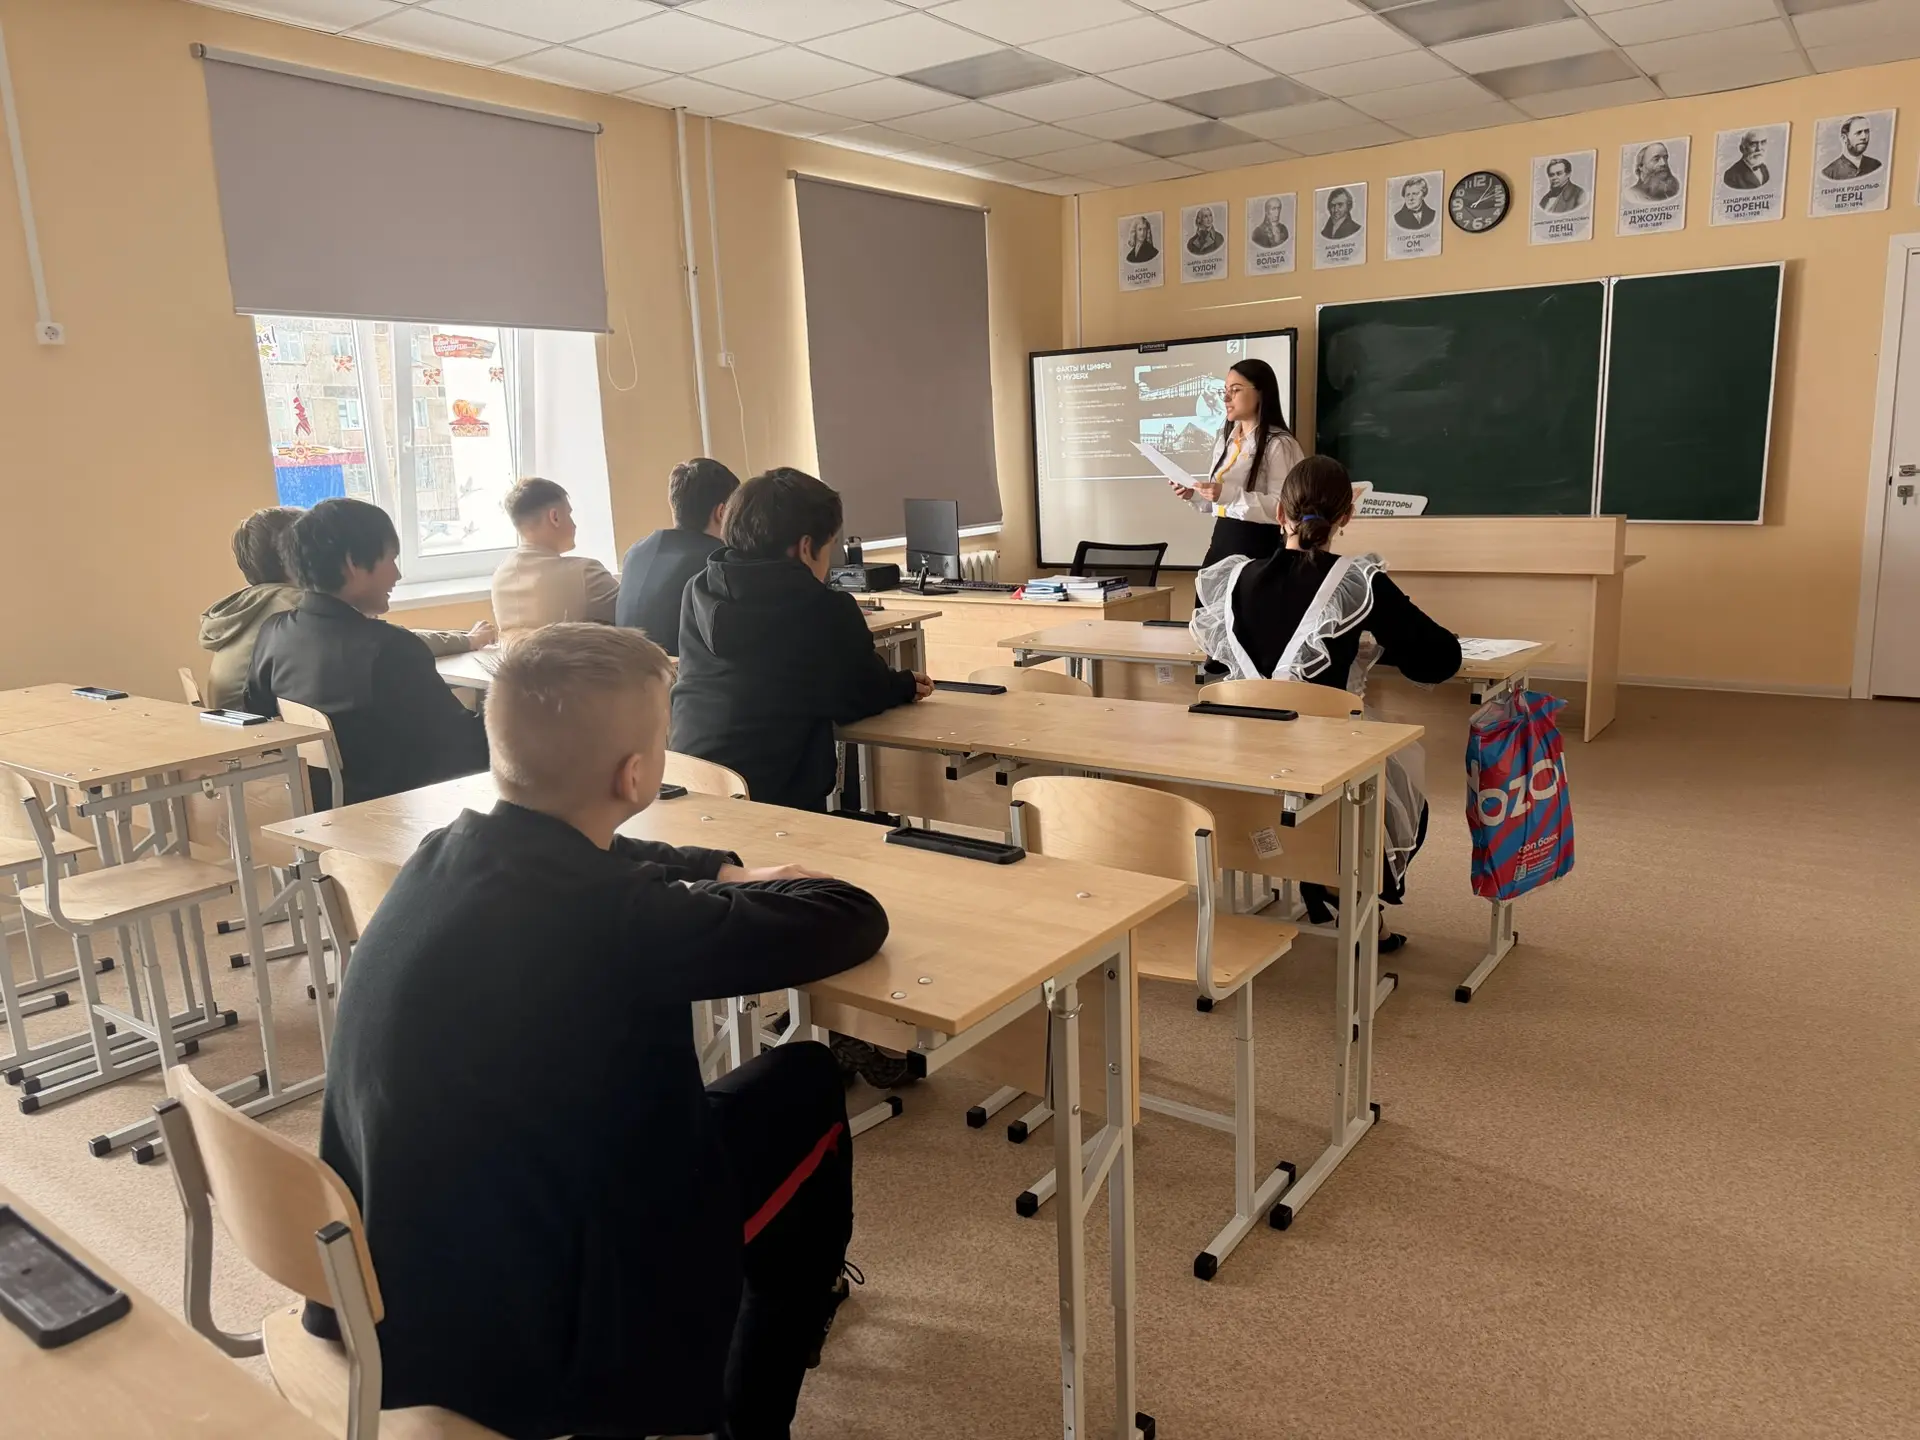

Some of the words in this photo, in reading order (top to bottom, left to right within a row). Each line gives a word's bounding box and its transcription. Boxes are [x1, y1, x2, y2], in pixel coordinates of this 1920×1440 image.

[1465, 180, 1472, 189] 11
[1473, 175, 1486, 187] 12
[1456, 188, 1465, 197] 10
[1821, 186, 1846, 195] ГЕНРИХ
[1847, 183, 1880, 192] РУДОЛЬФ
[1722, 196, 1751, 204] ХЕНДРИК
[1751, 193, 1774, 201] АНТОН
[1835, 192, 1863, 203] ГЕРЦ
[1452, 198, 1464, 211] 9
[1725, 201, 1770, 213] ЛОРЕНЦ
[1456, 212, 1463, 220] 8
[1628, 212, 1673, 225] ДЖОУЛЬ
[1463, 219, 1470, 228] 7
[1472, 217, 1483, 230] 6
[1485, 218, 1492, 226] 5
[1548, 223, 1574, 233] ЛЕНЦ
[1406, 240, 1421, 248] ОМ
[1326, 247, 1354, 259] АМПЕР
[1256, 255, 1286, 267] ВОЛЬТА
[1192, 263, 1217, 274] КУЛОН
[1127, 271, 1157, 283] НЬЮТОН
[1055, 364, 1079, 373] ФАКТЫ
[1086, 362, 1112, 371] ЦИФРЫ
[1362, 498, 1413, 509] НАВИГАТОРЫ
[1360, 506, 1394, 516] ДЕТСТВА
